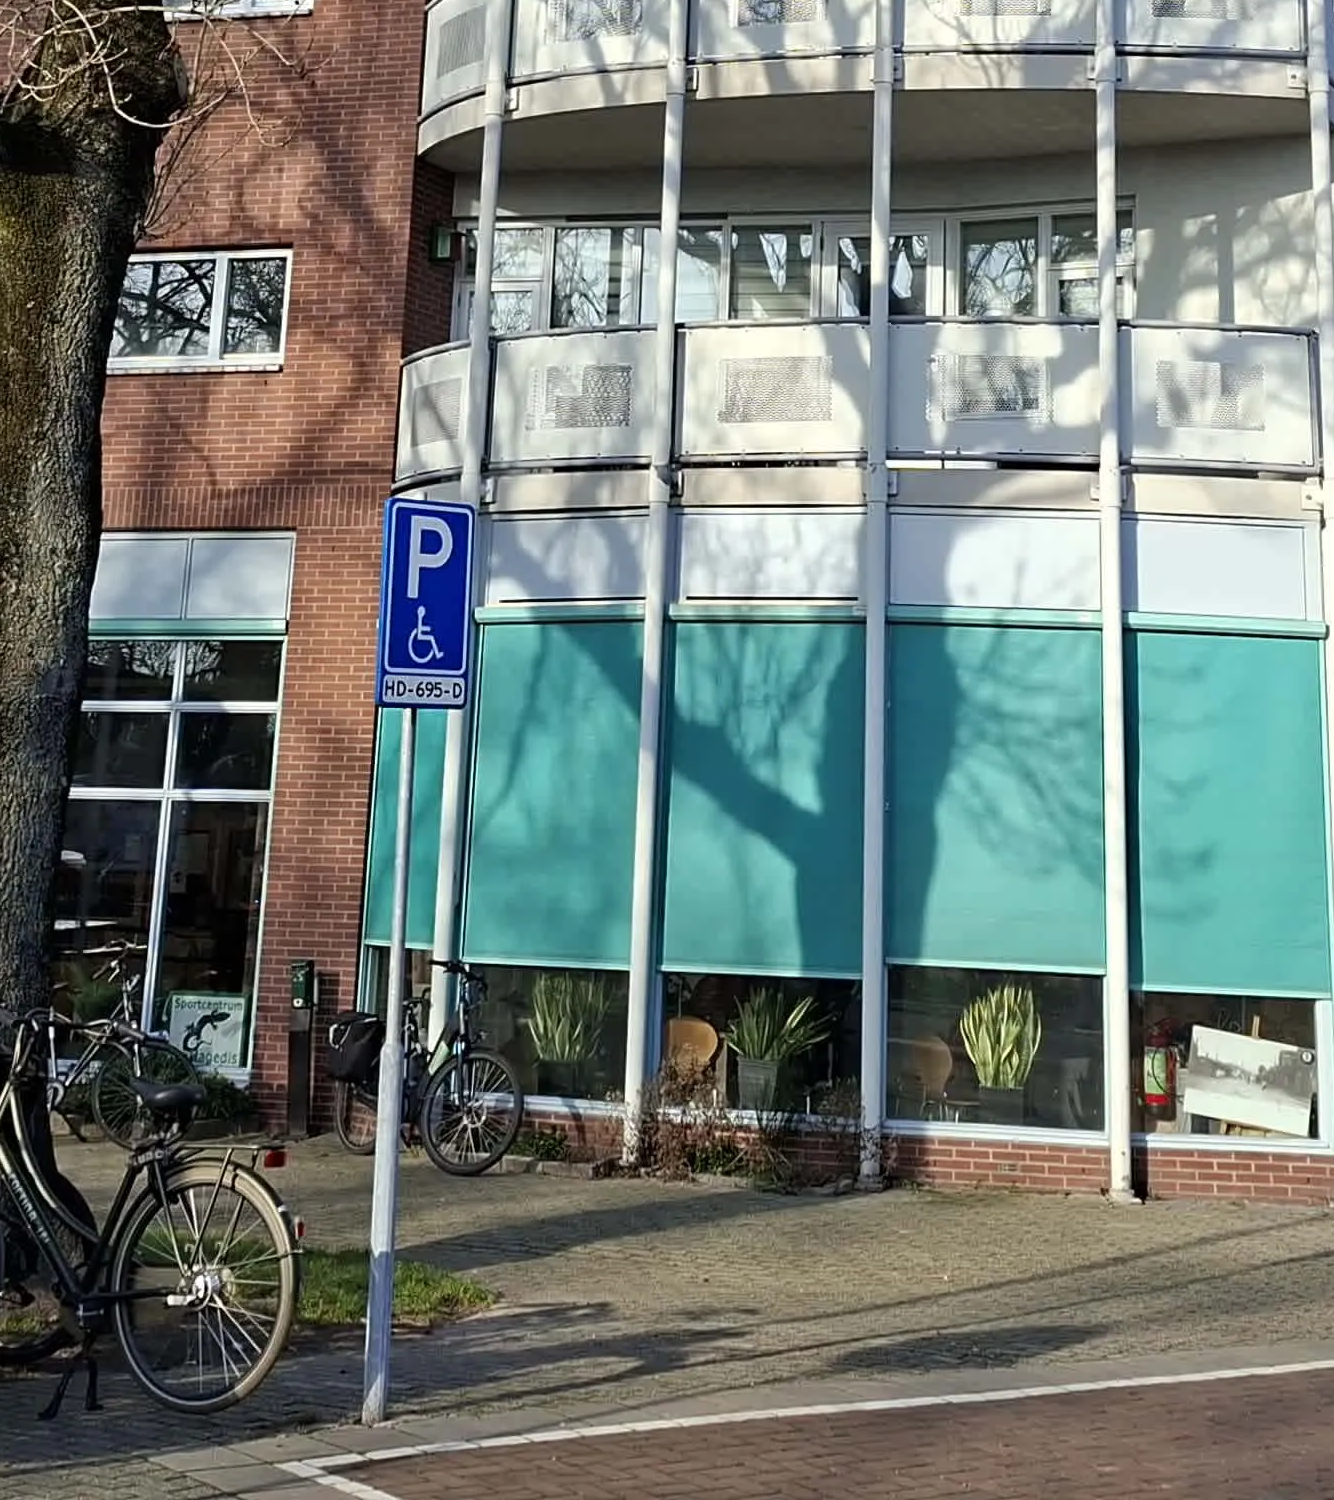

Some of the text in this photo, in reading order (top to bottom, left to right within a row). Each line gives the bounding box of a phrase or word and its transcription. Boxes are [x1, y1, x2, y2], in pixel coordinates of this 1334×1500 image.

[406, 515, 454, 599] P
[384, 679, 463, 700] HD-695-D
[174, 997, 243, 1012] Sportcentrum
